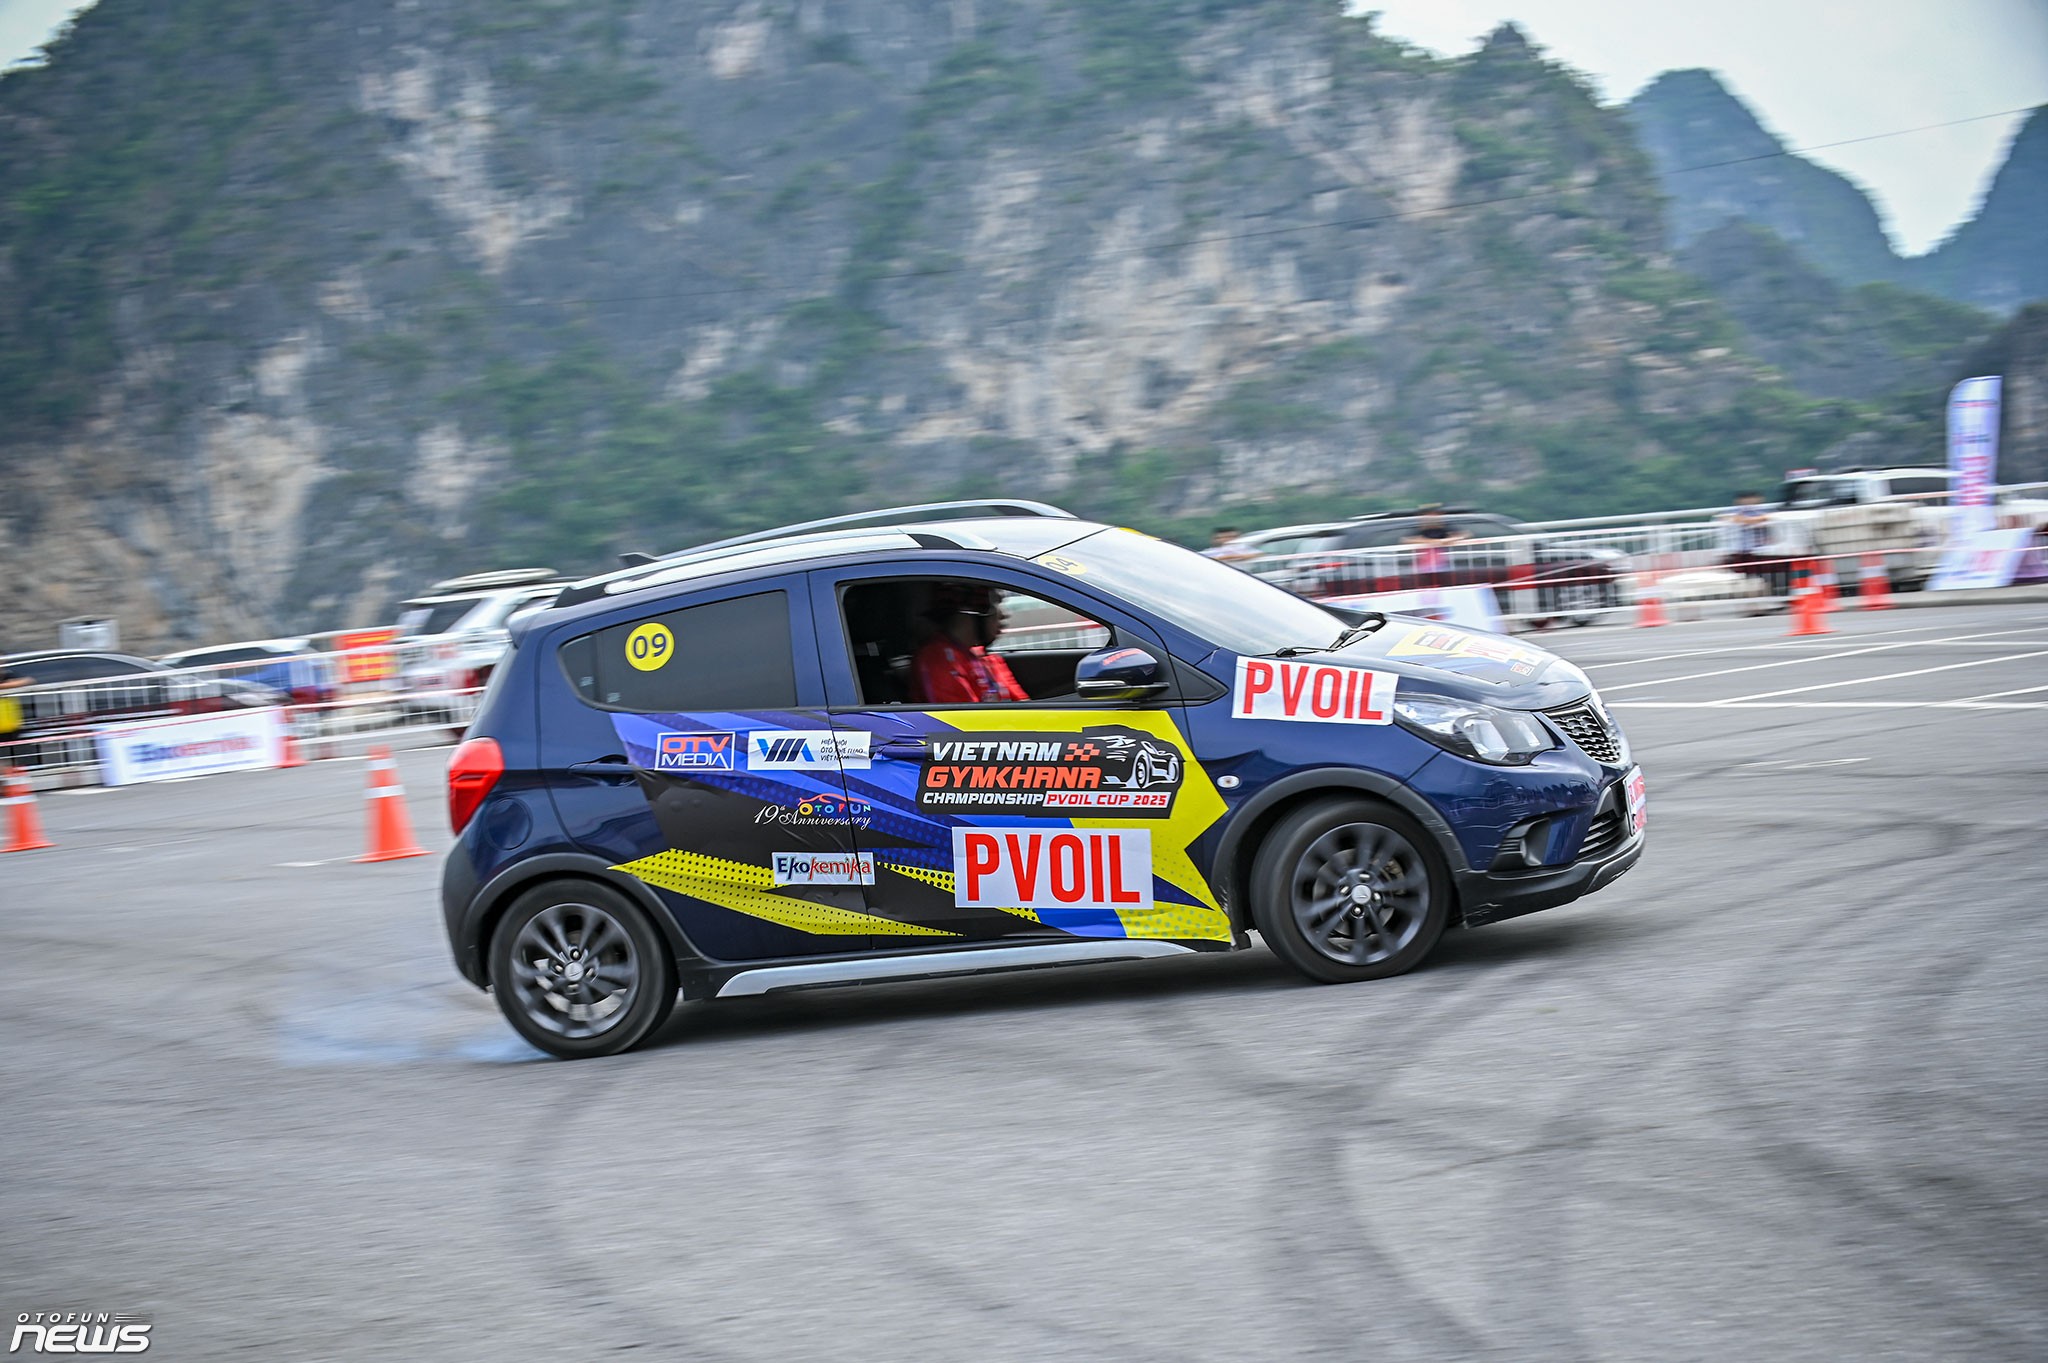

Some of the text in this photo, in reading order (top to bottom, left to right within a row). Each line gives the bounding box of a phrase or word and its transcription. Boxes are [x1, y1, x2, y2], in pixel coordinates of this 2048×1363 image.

[633, 632, 667, 660] 09
[1242, 661, 1384, 721] PVOIL
[662, 736, 731, 753] OTV
[933, 742, 1062, 762] VIETNAM
[661, 752, 730, 769] MEDIA
[926, 766, 1101, 789] GYMKHANA
[922, 792, 1167, 806] CHAMPIONSHIP PVOIL CUP 2025
[779, 808, 872, 831] Anniversary
[777, 857, 871, 881] Ekokemika
[964, 833, 1142, 903] PVOIL
